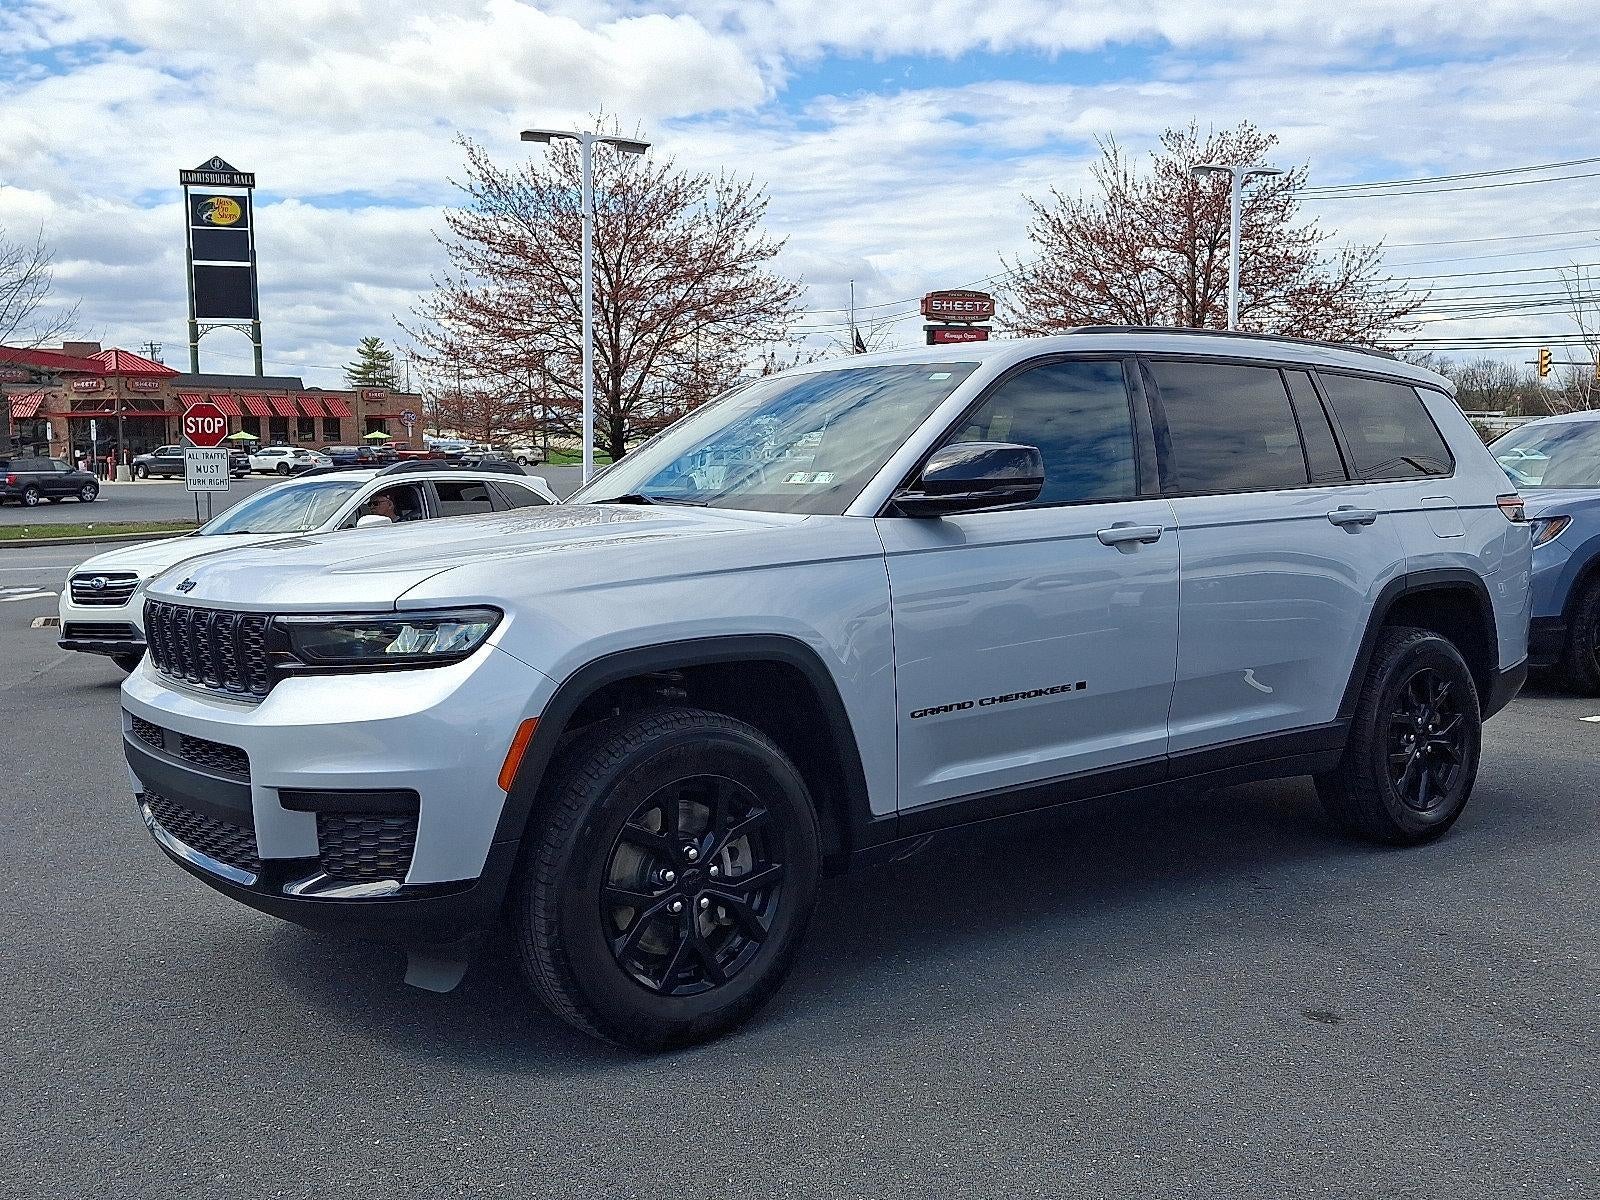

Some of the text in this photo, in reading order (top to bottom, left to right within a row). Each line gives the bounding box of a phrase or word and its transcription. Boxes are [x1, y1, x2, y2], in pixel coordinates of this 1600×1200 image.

[181, 172, 254, 185] HARRISBURG MALL
[217, 212, 238, 220] Shops
[932, 300, 991, 312] SHEETZ
[944, 332, 963, 340] Always
[186, 416, 225, 434] STOP
[187, 452, 227, 460] ALL TRAFFIC
[195, 464, 220, 474] MUST
[189, 478, 228, 486] TURN RIGHT
[910, 700, 974, 719] GRAND
[978, 683, 1072, 707] CHEROKEE
